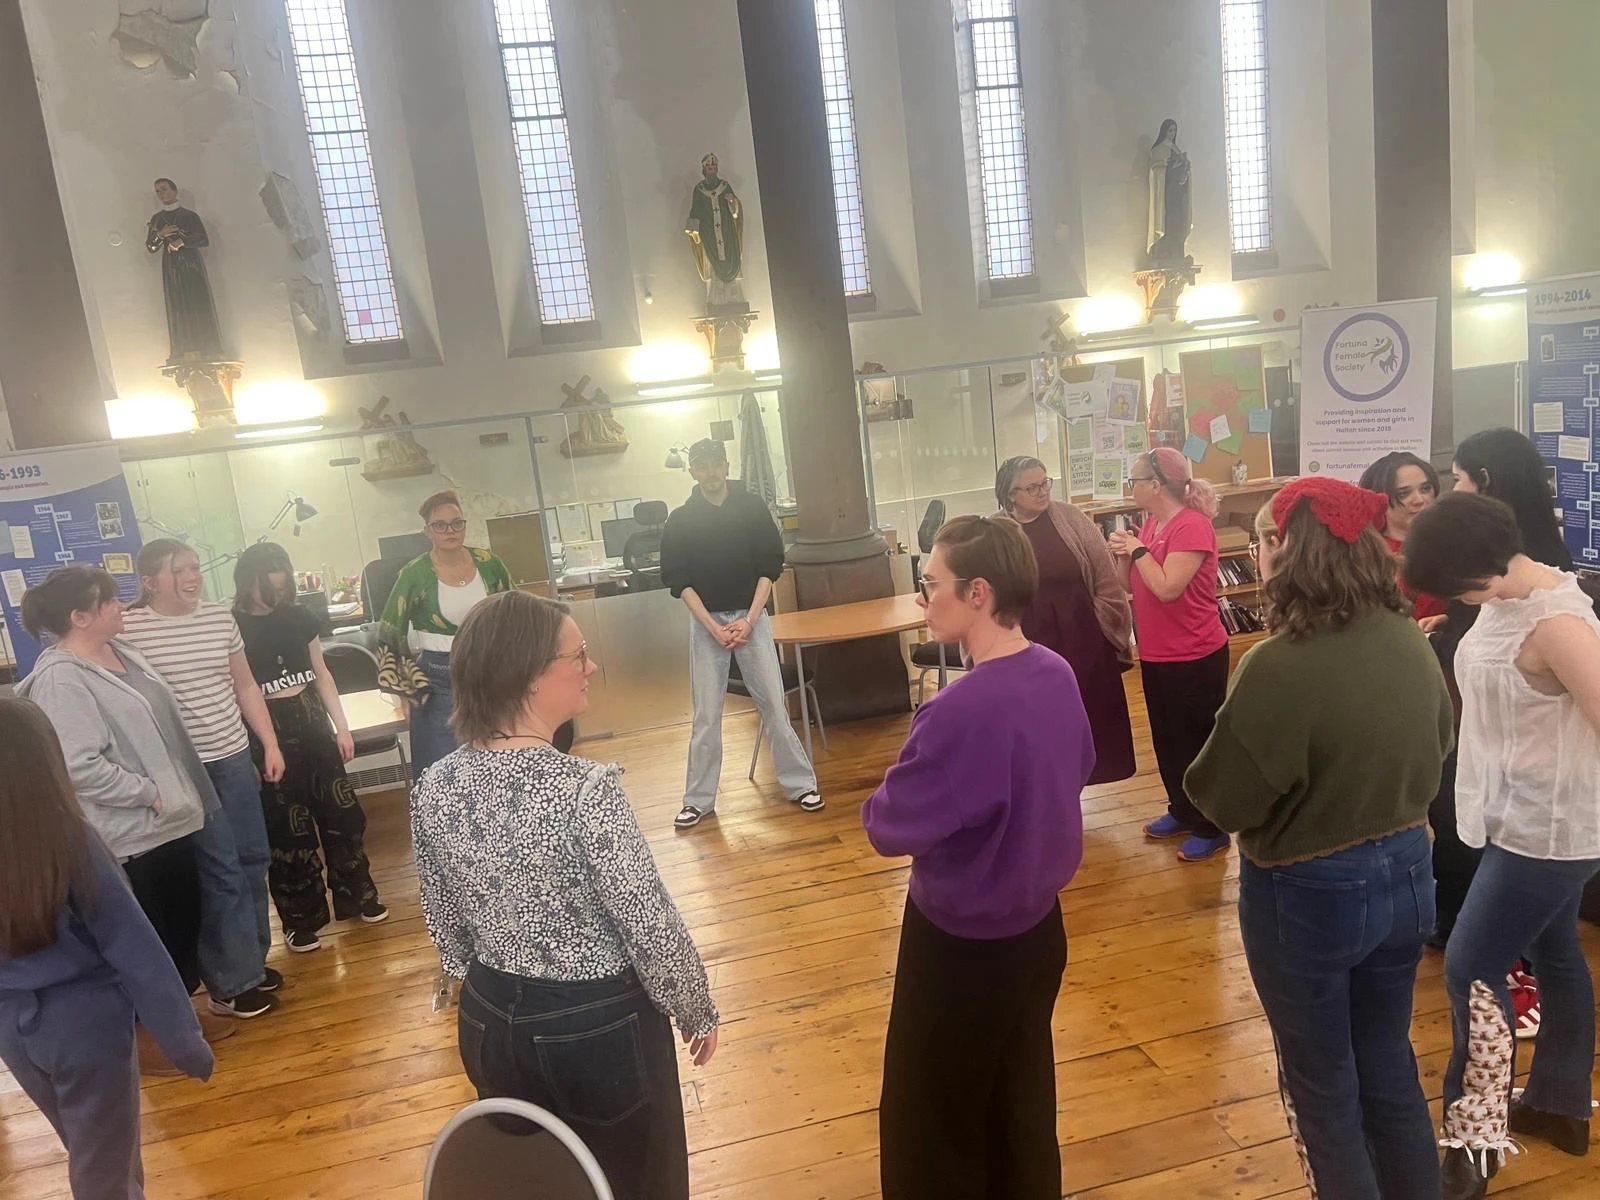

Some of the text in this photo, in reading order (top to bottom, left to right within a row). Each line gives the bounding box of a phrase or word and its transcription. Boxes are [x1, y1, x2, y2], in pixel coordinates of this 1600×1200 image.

[1535, 289, 1592, 305] 1994-2014
[1335, 340, 1367, 349] Fortuna
[1335, 352, 1366, 360] Female
[1335, 363, 1365, 372] Society
[1323, 409, 1354, 417] Providing
[1355, 407, 1392, 416] inspiration
[1315, 418, 1341, 427] support
[1391, 415, 1407, 424] girls
